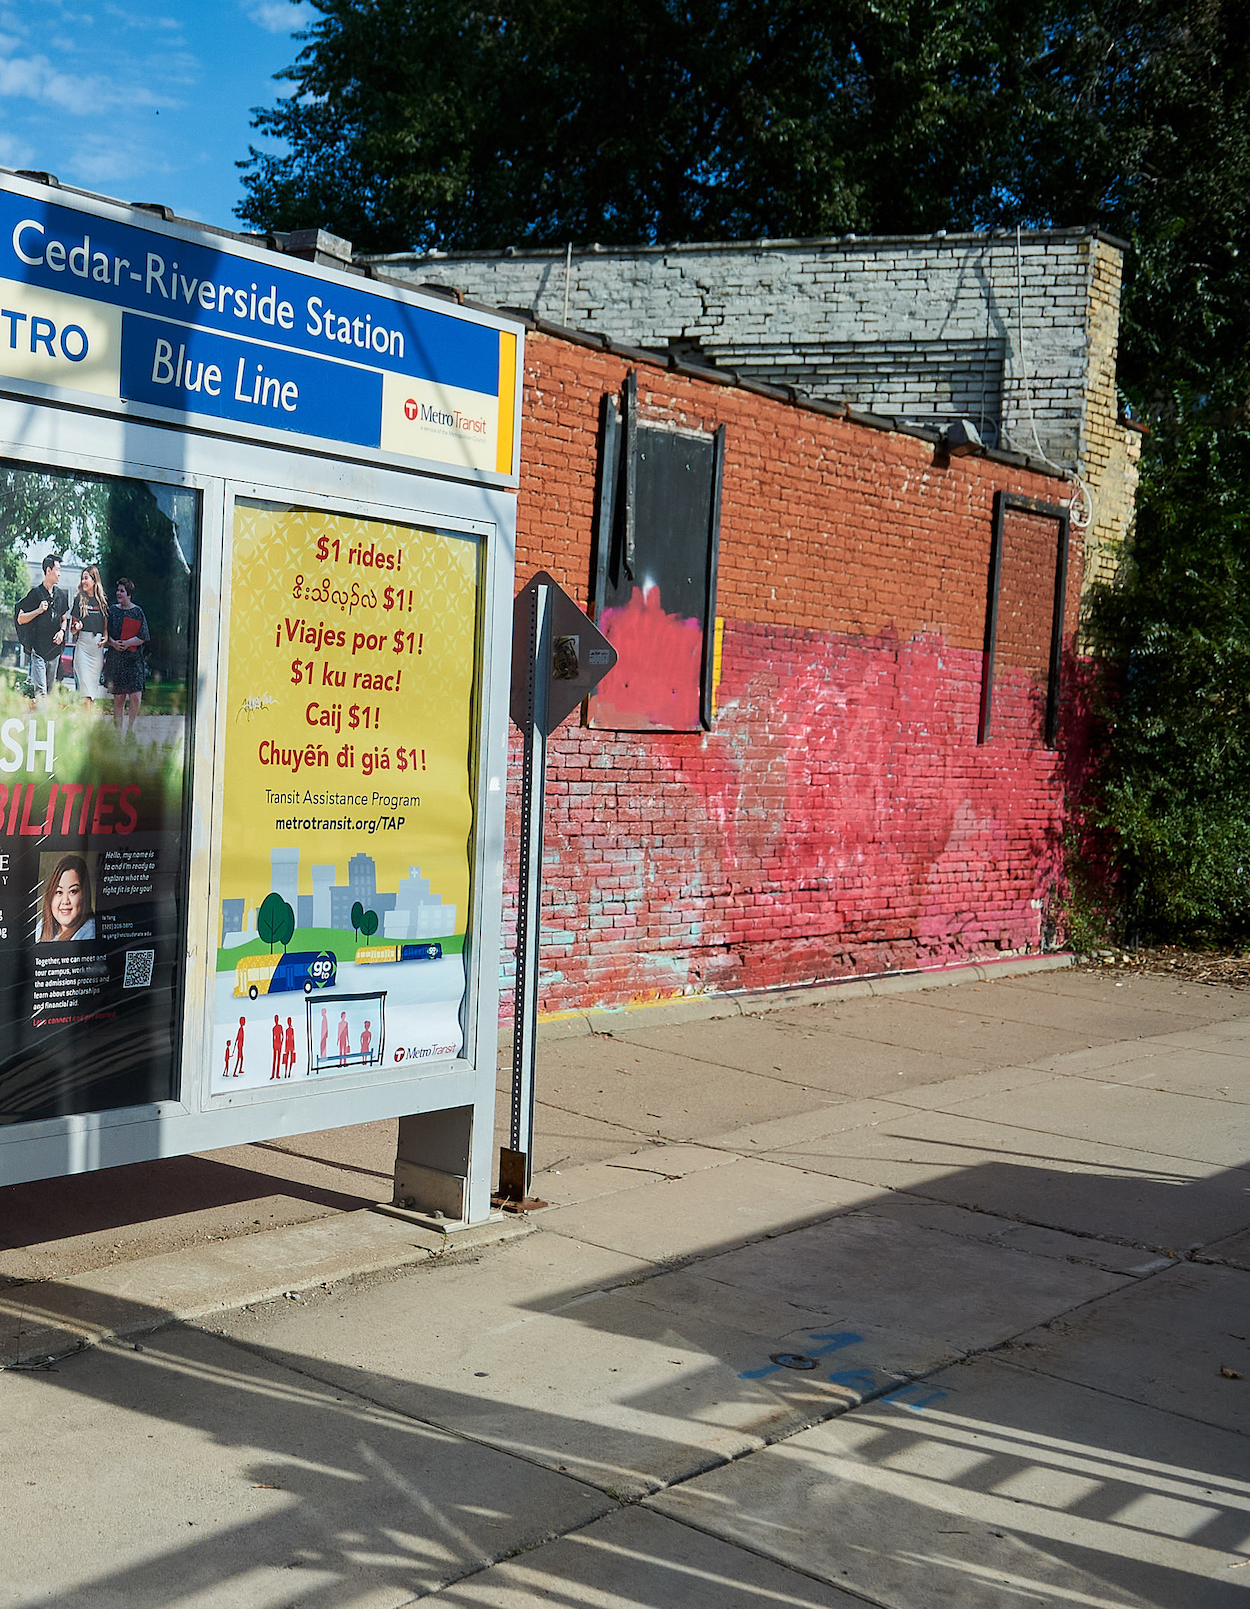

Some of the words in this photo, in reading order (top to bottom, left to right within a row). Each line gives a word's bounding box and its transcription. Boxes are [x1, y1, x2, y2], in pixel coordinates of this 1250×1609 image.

[12, 219, 294, 329] Cedar-Riverside
[306, 296, 404, 358] Station
[152, 338, 222, 396] Blue
[235, 357, 299, 411] Line
[316, 534, 340, 562] $1
[348, 542, 402, 571] rides!
[382, 585, 413, 612] $1!
[275, 617, 346, 652] ¡Viajes
[352, 630, 387, 654] por
[393, 629, 424, 655] $1!
[291, 658, 314, 685] $1
[322, 661, 346, 687] ku
[352, 670, 402, 692] raac!
[305, 702, 342, 734] Caij
[348, 703, 380, 730] $1!
[259, 740, 329, 773] Chuyến
[336, 743, 354, 768] đi
[362, 747, 390, 775] giá
[396, 747, 427, 772] $1!
[265, 789, 300, 804] Transit
[303, 790, 368, 806] Assistance
[372, 792, 421, 810] Program
[275, 815, 406, 834] metrotransit.org/TAP
[132, 862, 148, 871] ready
[103, 875, 124, 884] explore
[102, 886, 117, 896] right
[130, 885, 139, 895] for
[35, 957, 61, 967] Together,
[313, 961, 331, 976] go
[45, 978, 76, 987] admissions
[77, 977, 98, 986] process
[48, 968, 71, 977] campus,
[33, 991, 48, 999] learn
[49, 990, 65, 998] about
[66, 987, 100, 996] scholarships
[45, 1000, 69, 1009] financial
